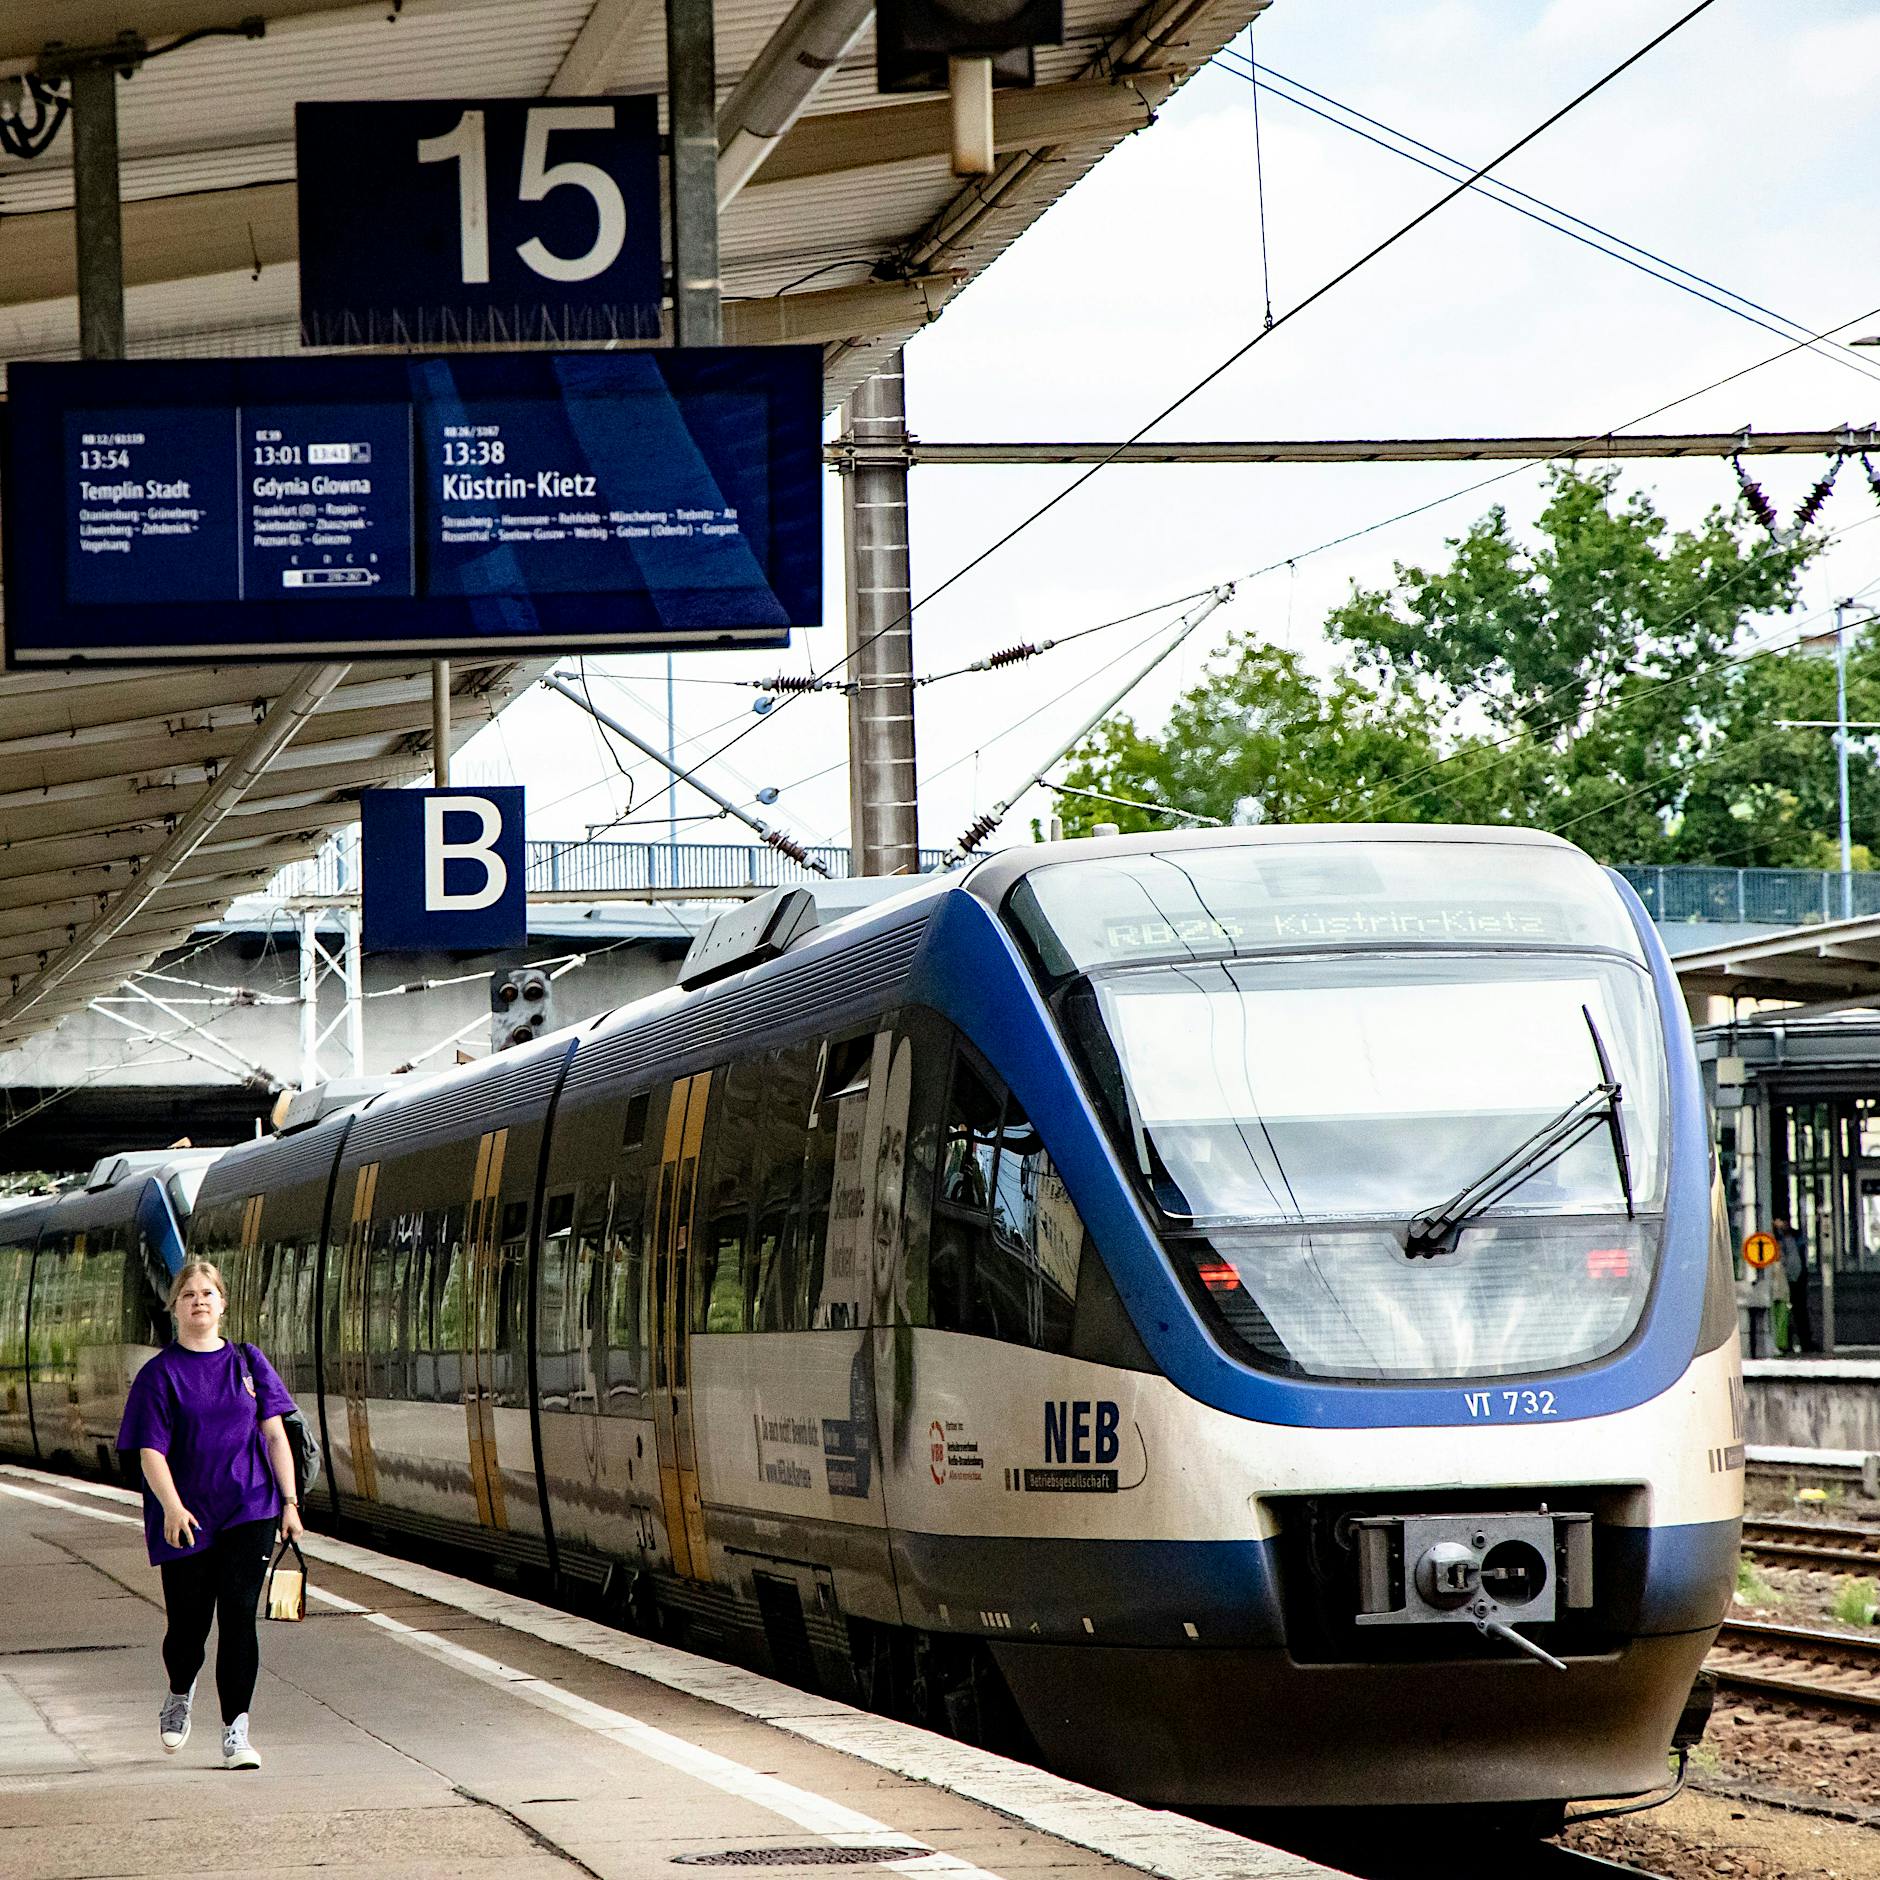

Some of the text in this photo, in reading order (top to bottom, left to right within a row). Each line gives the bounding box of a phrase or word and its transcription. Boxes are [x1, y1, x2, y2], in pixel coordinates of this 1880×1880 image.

[417, 106, 627, 283] 15
[80, 449, 130, 470] 13:54
[254, 446, 302, 466] 13:01
[443, 441, 505, 466] 13:38
[79, 479, 191, 504] Templin Stadt
[253, 476, 371, 500] Gdynia Glowna
[443, 471, 597, 500] Küstrin-Kietz
[79, 508, 140, 523] Oranienburg
[253, 504, 298, 517] Frankfurt
[424, 795, 508, 912] B
[1274, 910, 1545, 936] Küstrin-Kietz
[1464, 1390, 1558, 1417] VT 732
[1045, 1401, 1120, 1463] NEB
[1030, 1474, 1110, 1490] Betriebsgesellschaft
